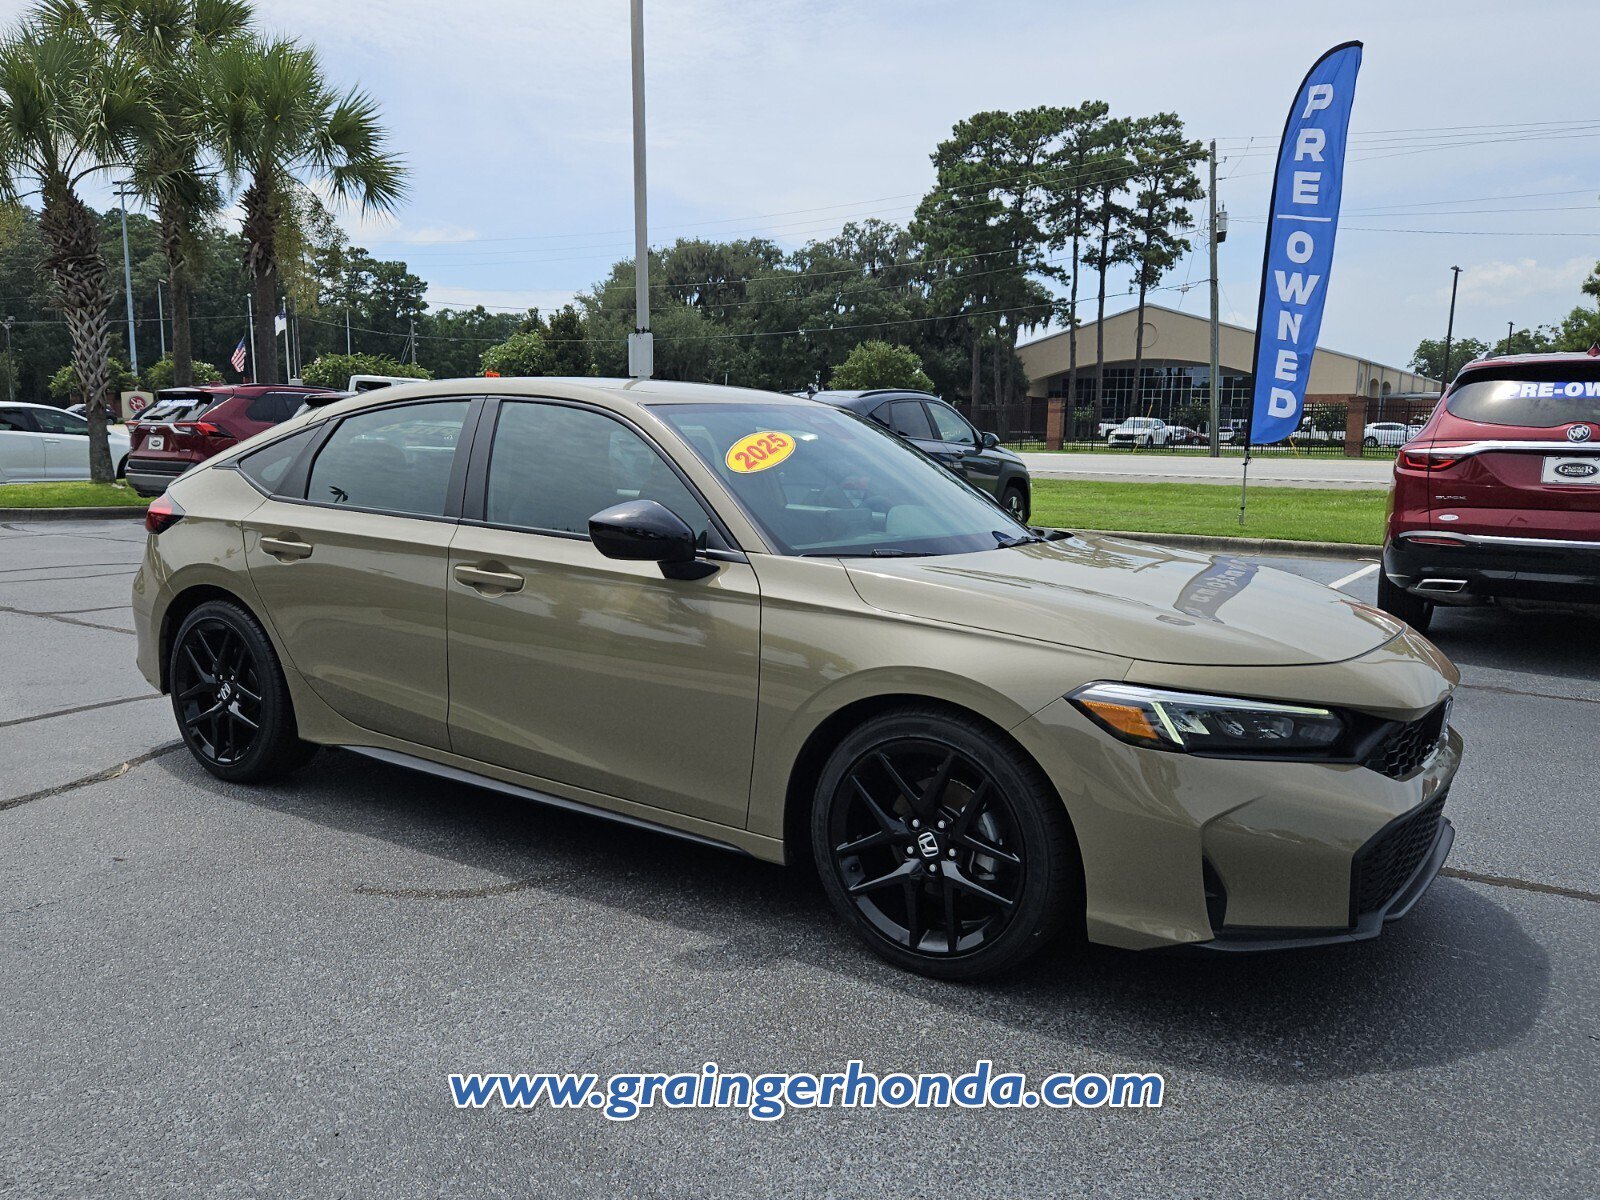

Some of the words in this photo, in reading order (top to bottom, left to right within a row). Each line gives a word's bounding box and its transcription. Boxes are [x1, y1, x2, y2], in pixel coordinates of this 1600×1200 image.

[1292, 83, 1334, 205] PRE
[1267, 230, 1321, 419] OWNED
[734, 432, 788, 470] 2025
